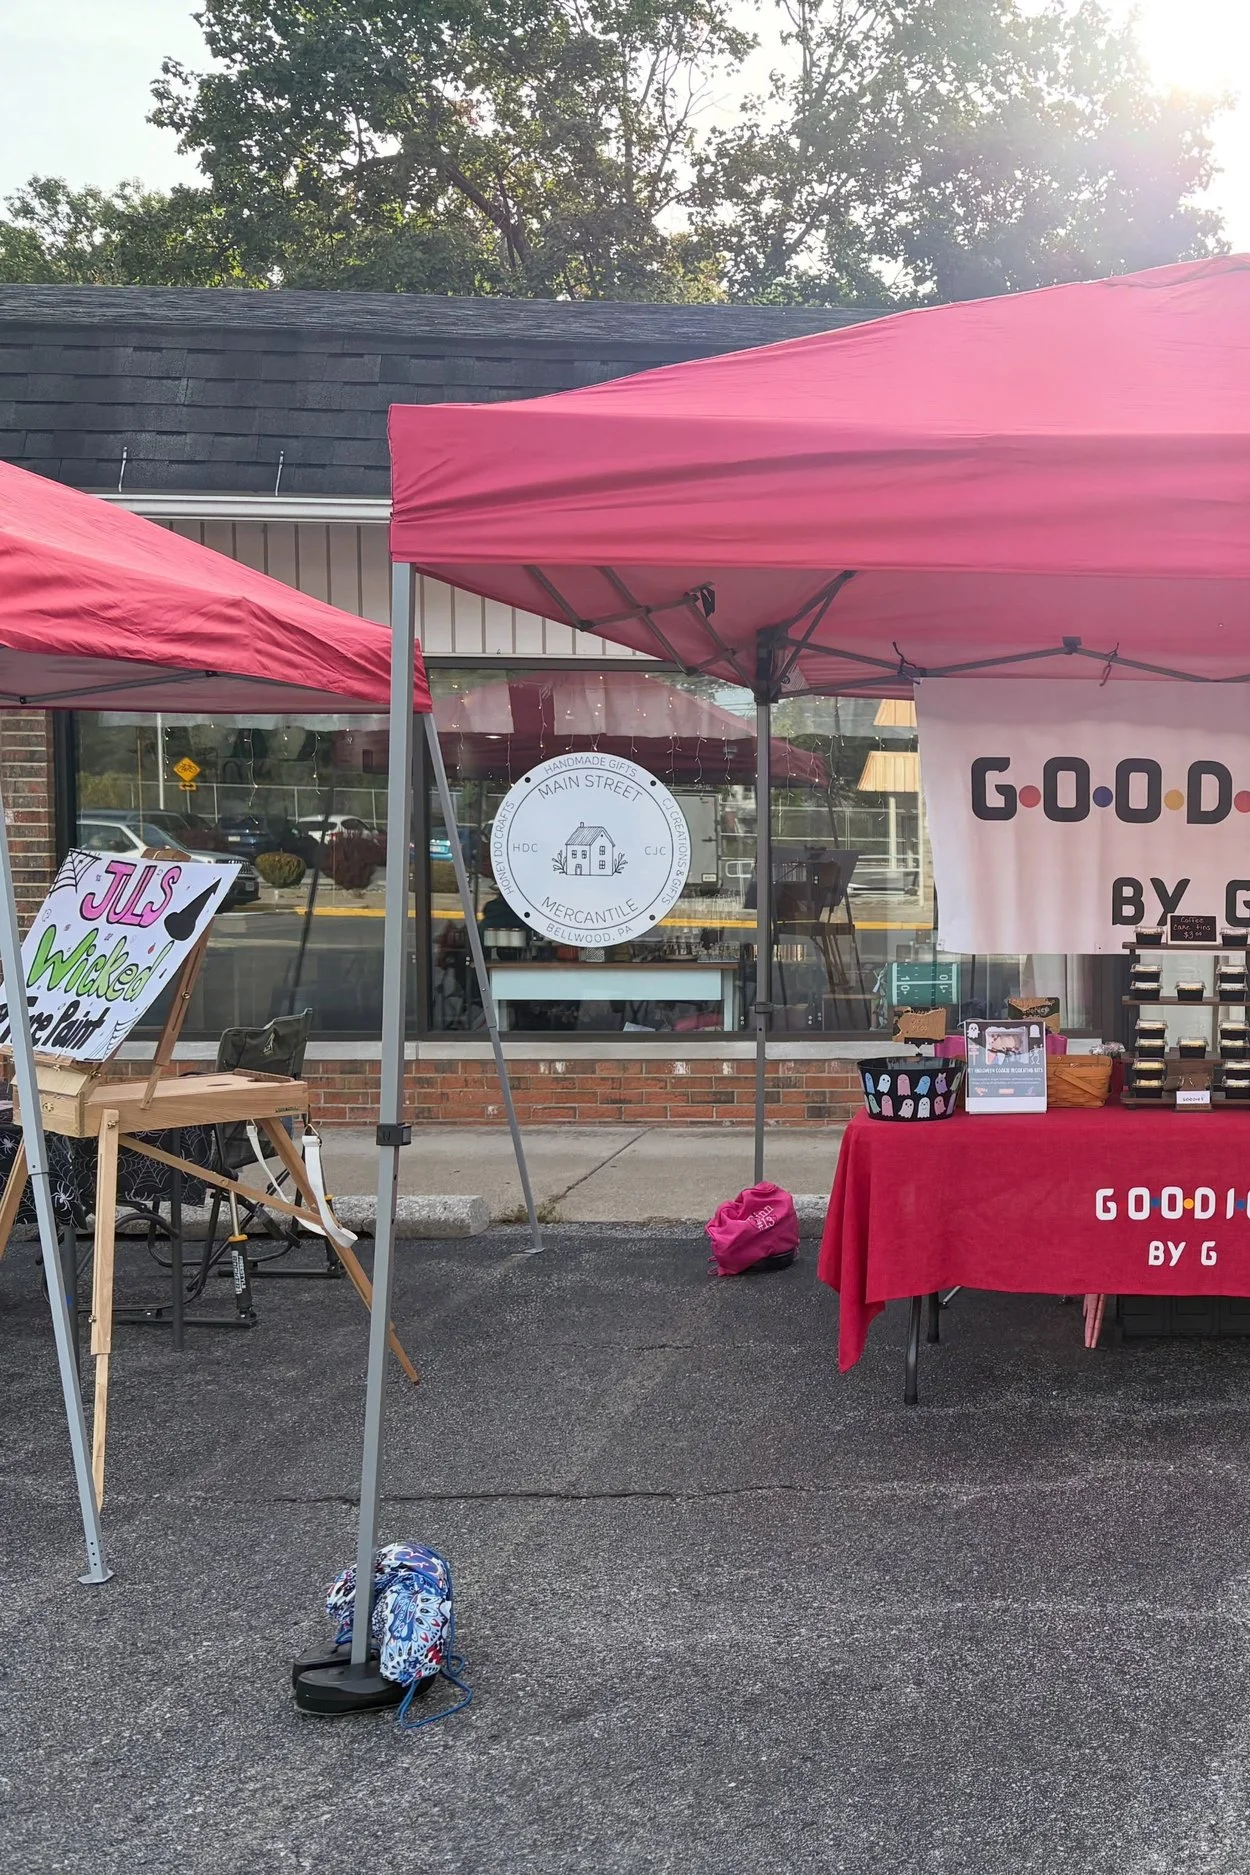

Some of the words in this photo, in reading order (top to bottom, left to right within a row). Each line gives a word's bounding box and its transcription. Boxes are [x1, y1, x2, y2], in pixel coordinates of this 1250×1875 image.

[543, 756, 606, 775] HANDMADE
[608, 759, 638, 778] GIFTS
[537, 775, 580, 800] MAIN
[585, 774, 642, 802] STREET
[662, 798, 675, 811] CJ
[494, 801, 515, 838] CRAFTS
[494, 840, 503, 856] DO
[512, 843, 538, 853] HDC
[644, 846, 667, 856] CJC
[670, 810, 687, 871] CREATIONS
[494, 860, 514, 896] HONEY
[677, 870, 685, 878] &
[79, 860, 182, 928] JULS
[661, 878, 682, 905] GIFTS
[1112, 876, 1191, 926] BY
[541, 896, 638, 925] MERCANTILE
[617, 925, 633, 938] PA
[26, 924, 175, 1002] Wicked
[41, 1000, 111, 1050] Paint
[1148, 1240, 1187, 1267] BY
[1201, 1240, 1217, 1266] G
